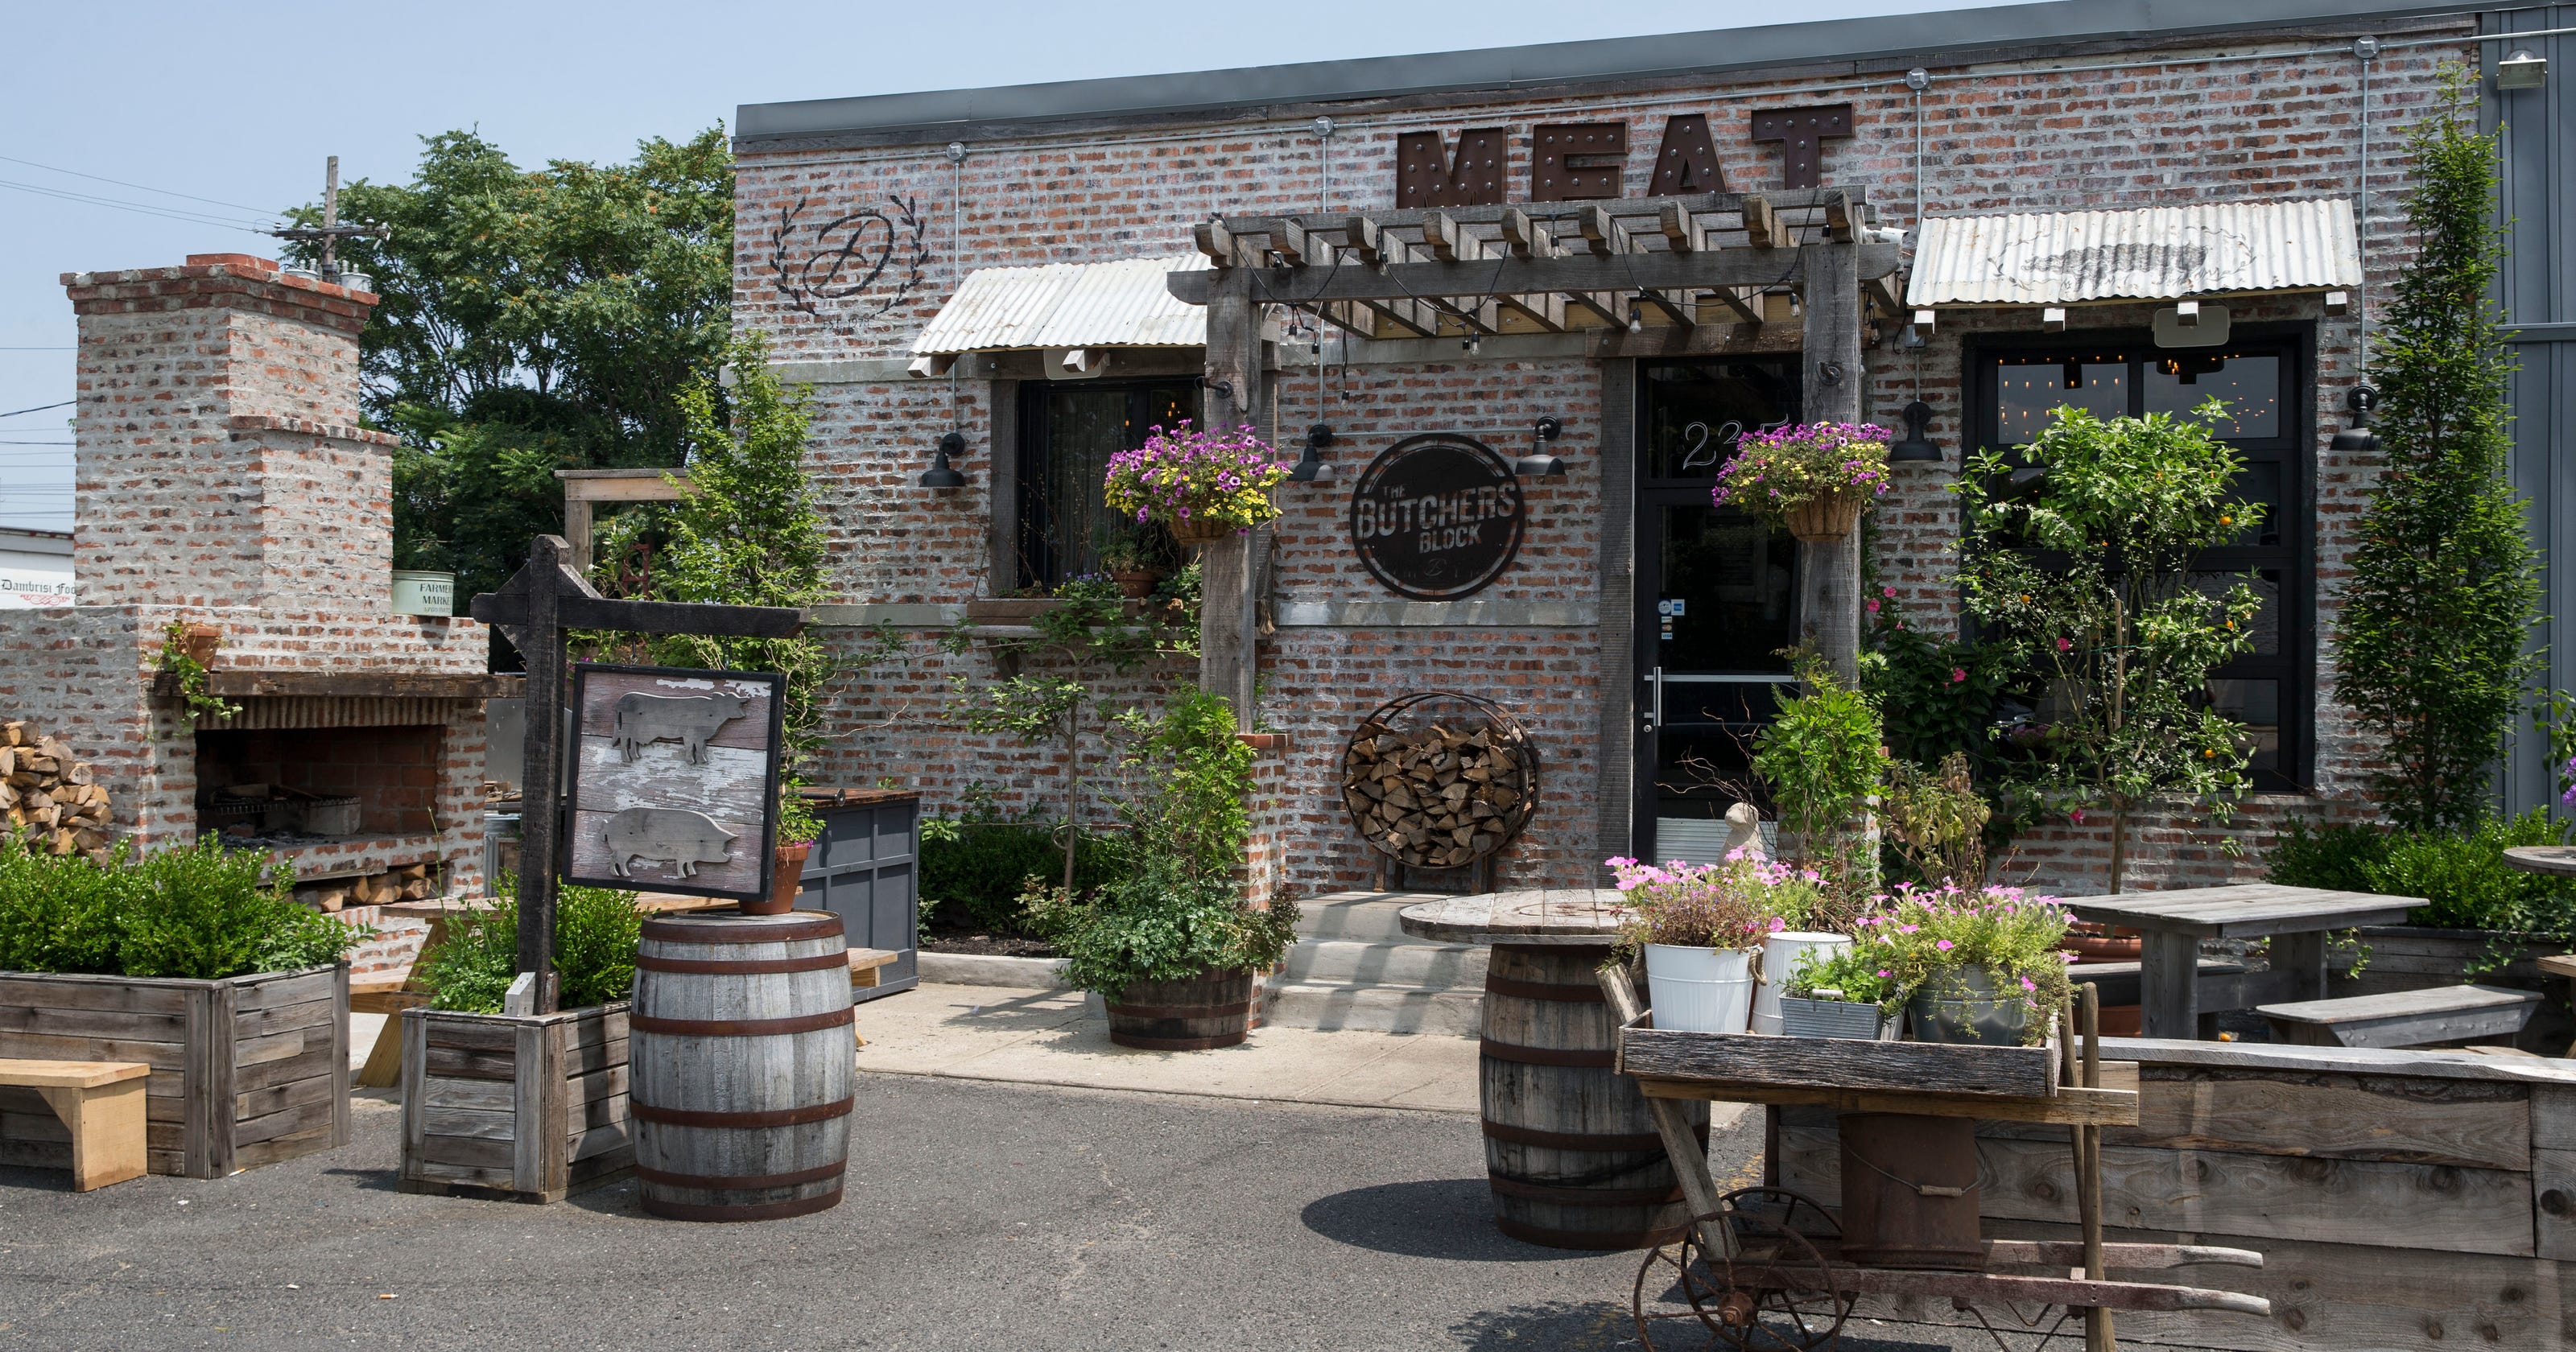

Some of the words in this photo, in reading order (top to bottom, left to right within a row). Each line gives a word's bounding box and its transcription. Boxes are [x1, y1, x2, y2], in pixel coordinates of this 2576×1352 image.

[1397, 104, 1855, 208] MEAT
[1383, 484, 1406, 499] THE
[1356, 481, 1517, 540] BUTCHERS
[1419, 522, 1482, 554] BLOCK
[2, 579, 52, 592] Dambrisi
